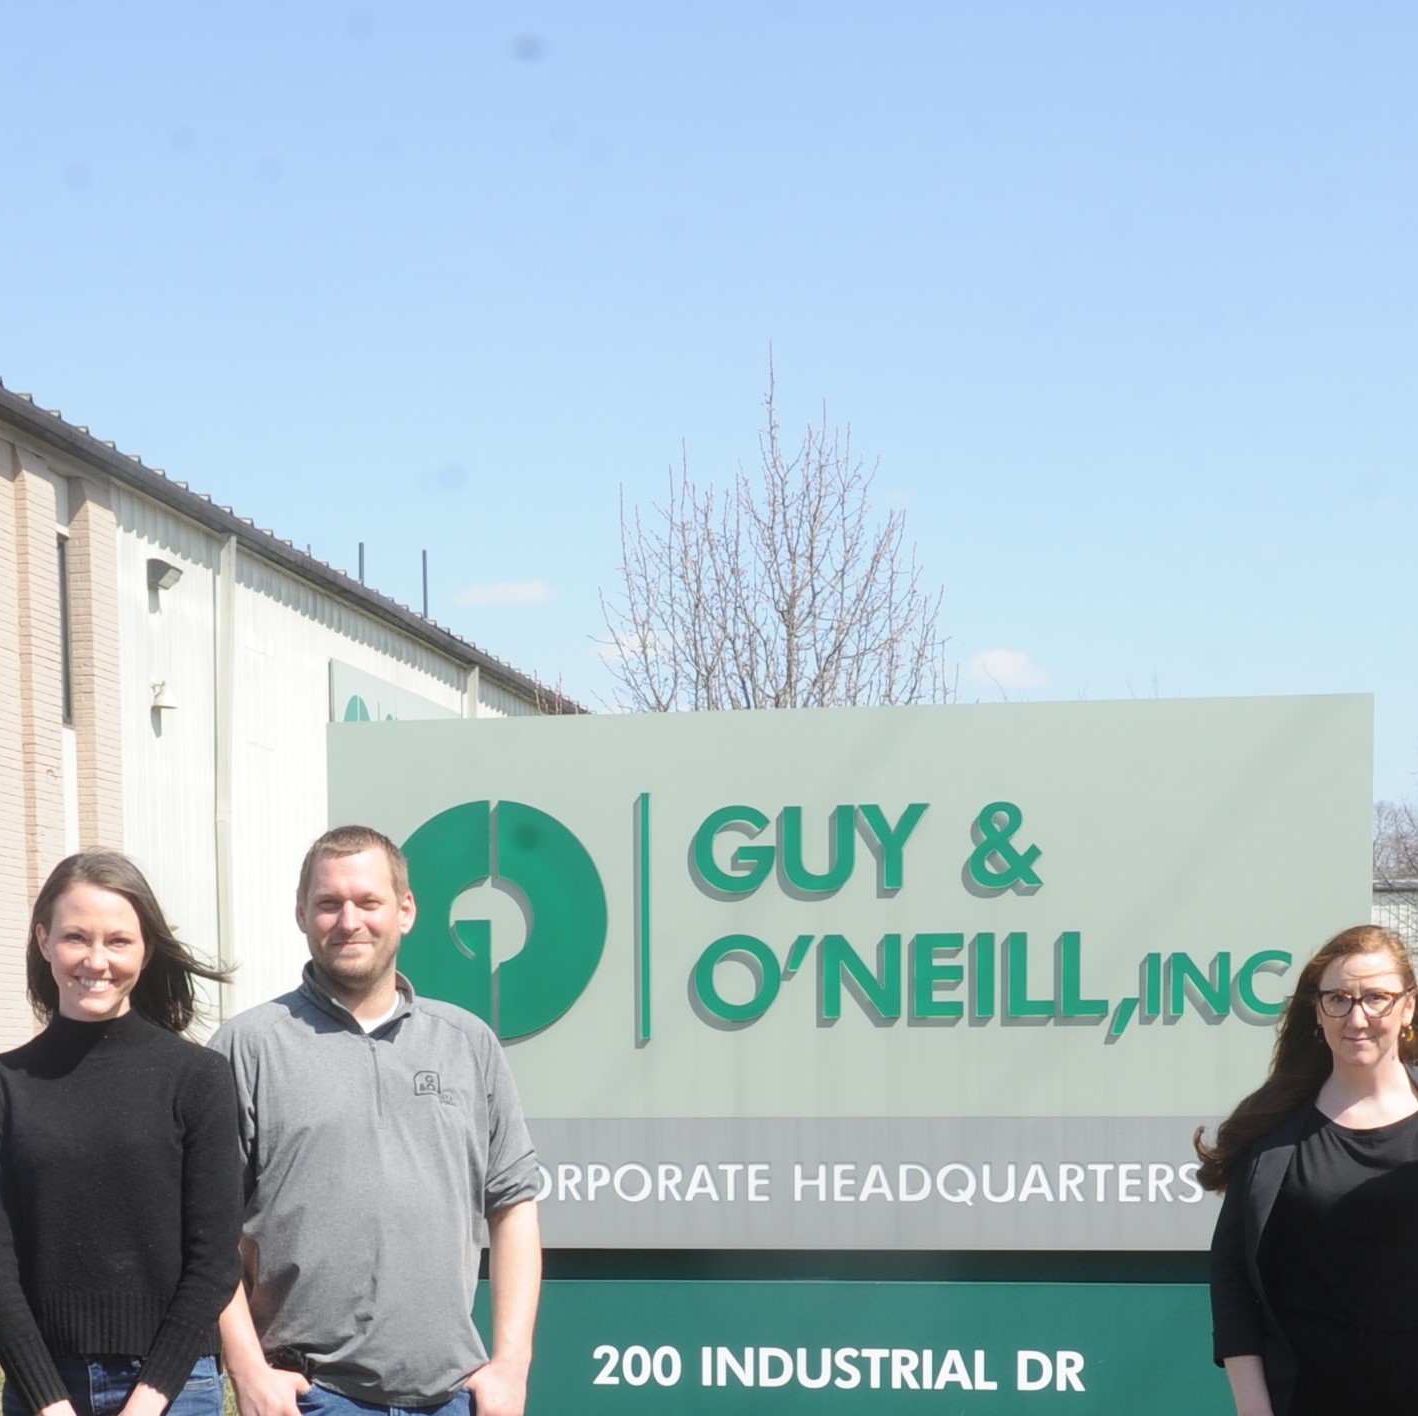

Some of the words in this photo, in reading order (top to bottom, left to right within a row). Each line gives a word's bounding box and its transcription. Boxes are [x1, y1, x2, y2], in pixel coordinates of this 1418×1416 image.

[688, 803, 930, 901] GUY
[963, 801, 1043, 898] &
[793, 1162, 1205, 1206] HEADQUARTERS
[592, 1344, 682, 1387] 200
[701, 1346, 998, 1390] INDUSTRIAL
[1016, 1350, 1086, 1392] DR
